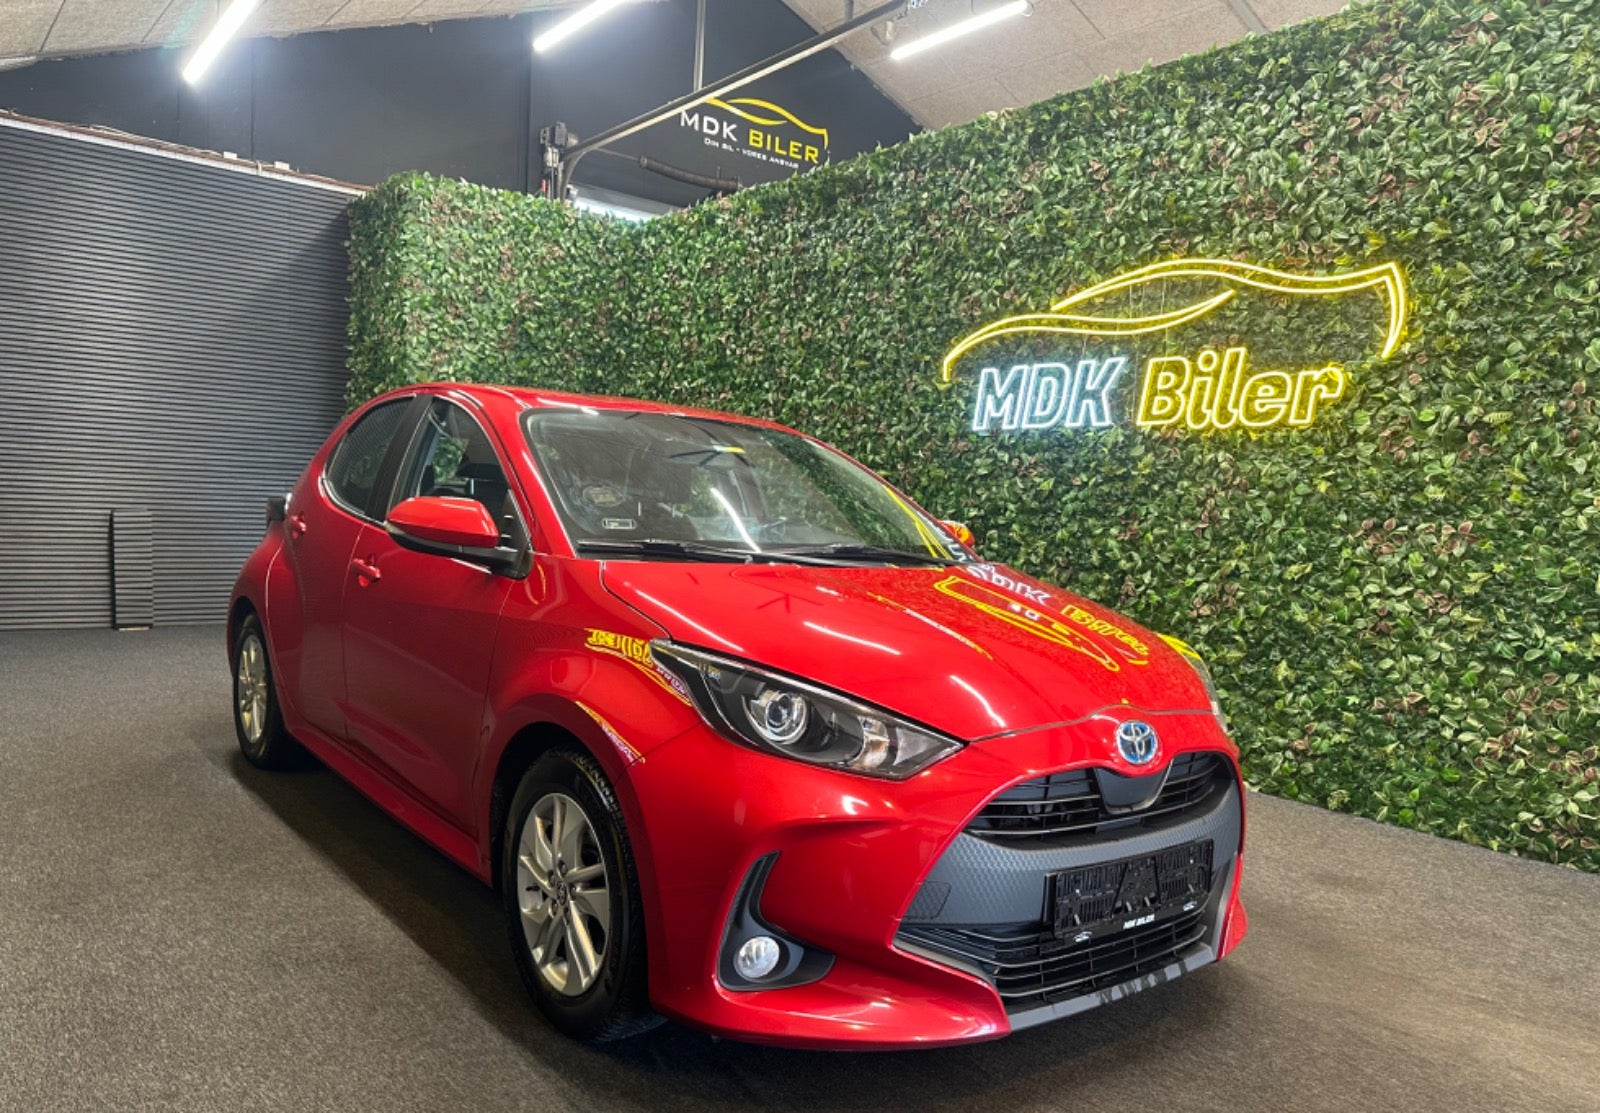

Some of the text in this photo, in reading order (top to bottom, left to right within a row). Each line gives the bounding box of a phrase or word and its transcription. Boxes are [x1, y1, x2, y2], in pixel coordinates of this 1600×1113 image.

[680, 110, 819, 164] MDK BILER
[972, 347, 1345, 432] MDK Biler
